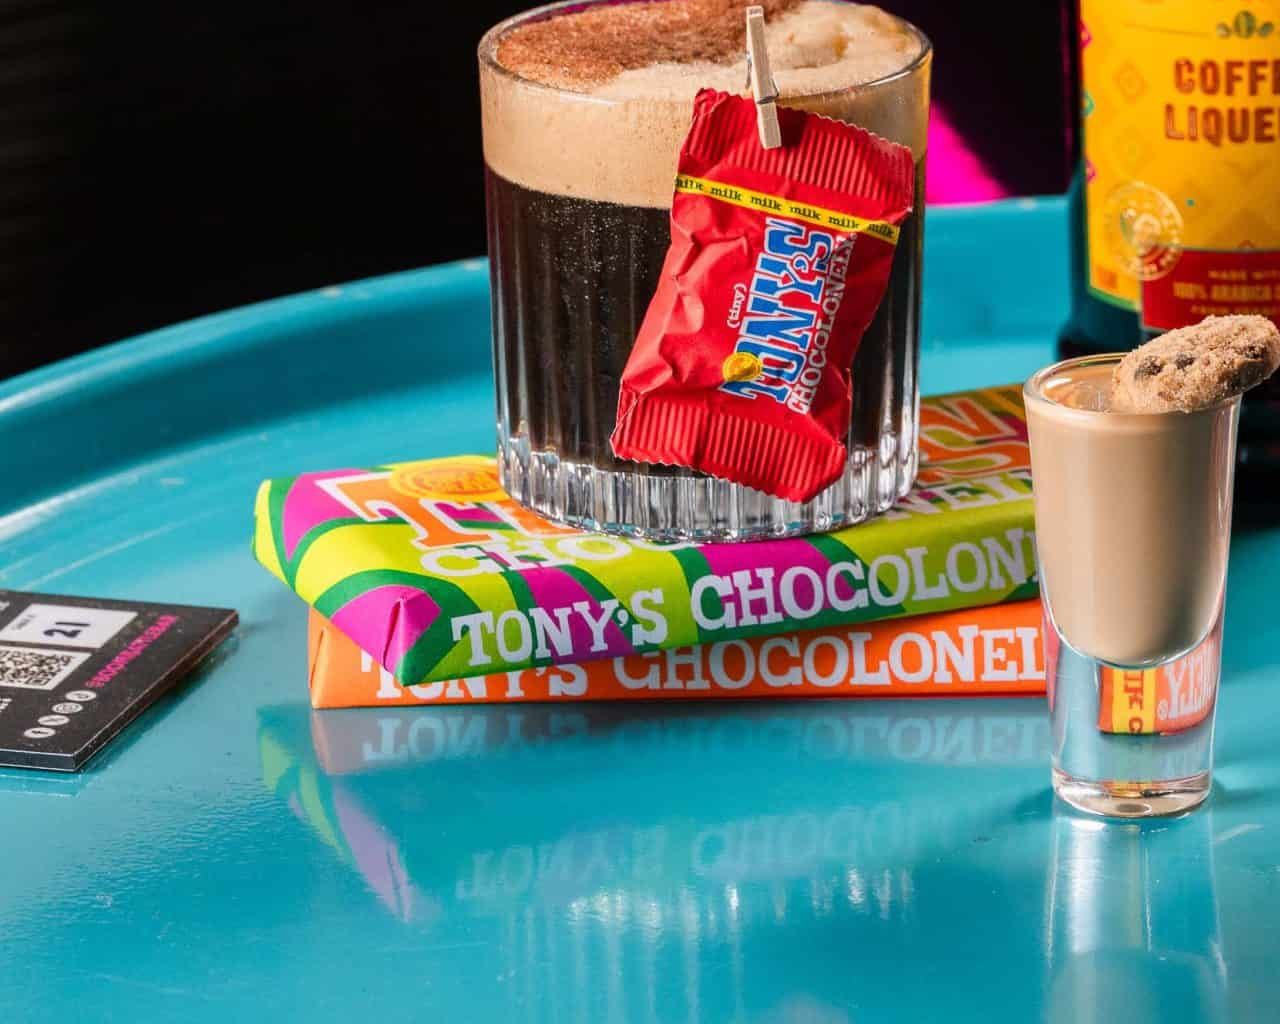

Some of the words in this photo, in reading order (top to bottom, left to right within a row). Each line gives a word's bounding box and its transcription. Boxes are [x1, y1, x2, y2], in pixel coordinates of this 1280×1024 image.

[710, 186, 742, 202] milk
[751, 195, 782, 211] milk
[790, 205, 821, 221] milk
[828, 214, 859, 229] milk
[717, 217, 833, 404] TONY'S
[451, 587, 668, 666] TONY'S
